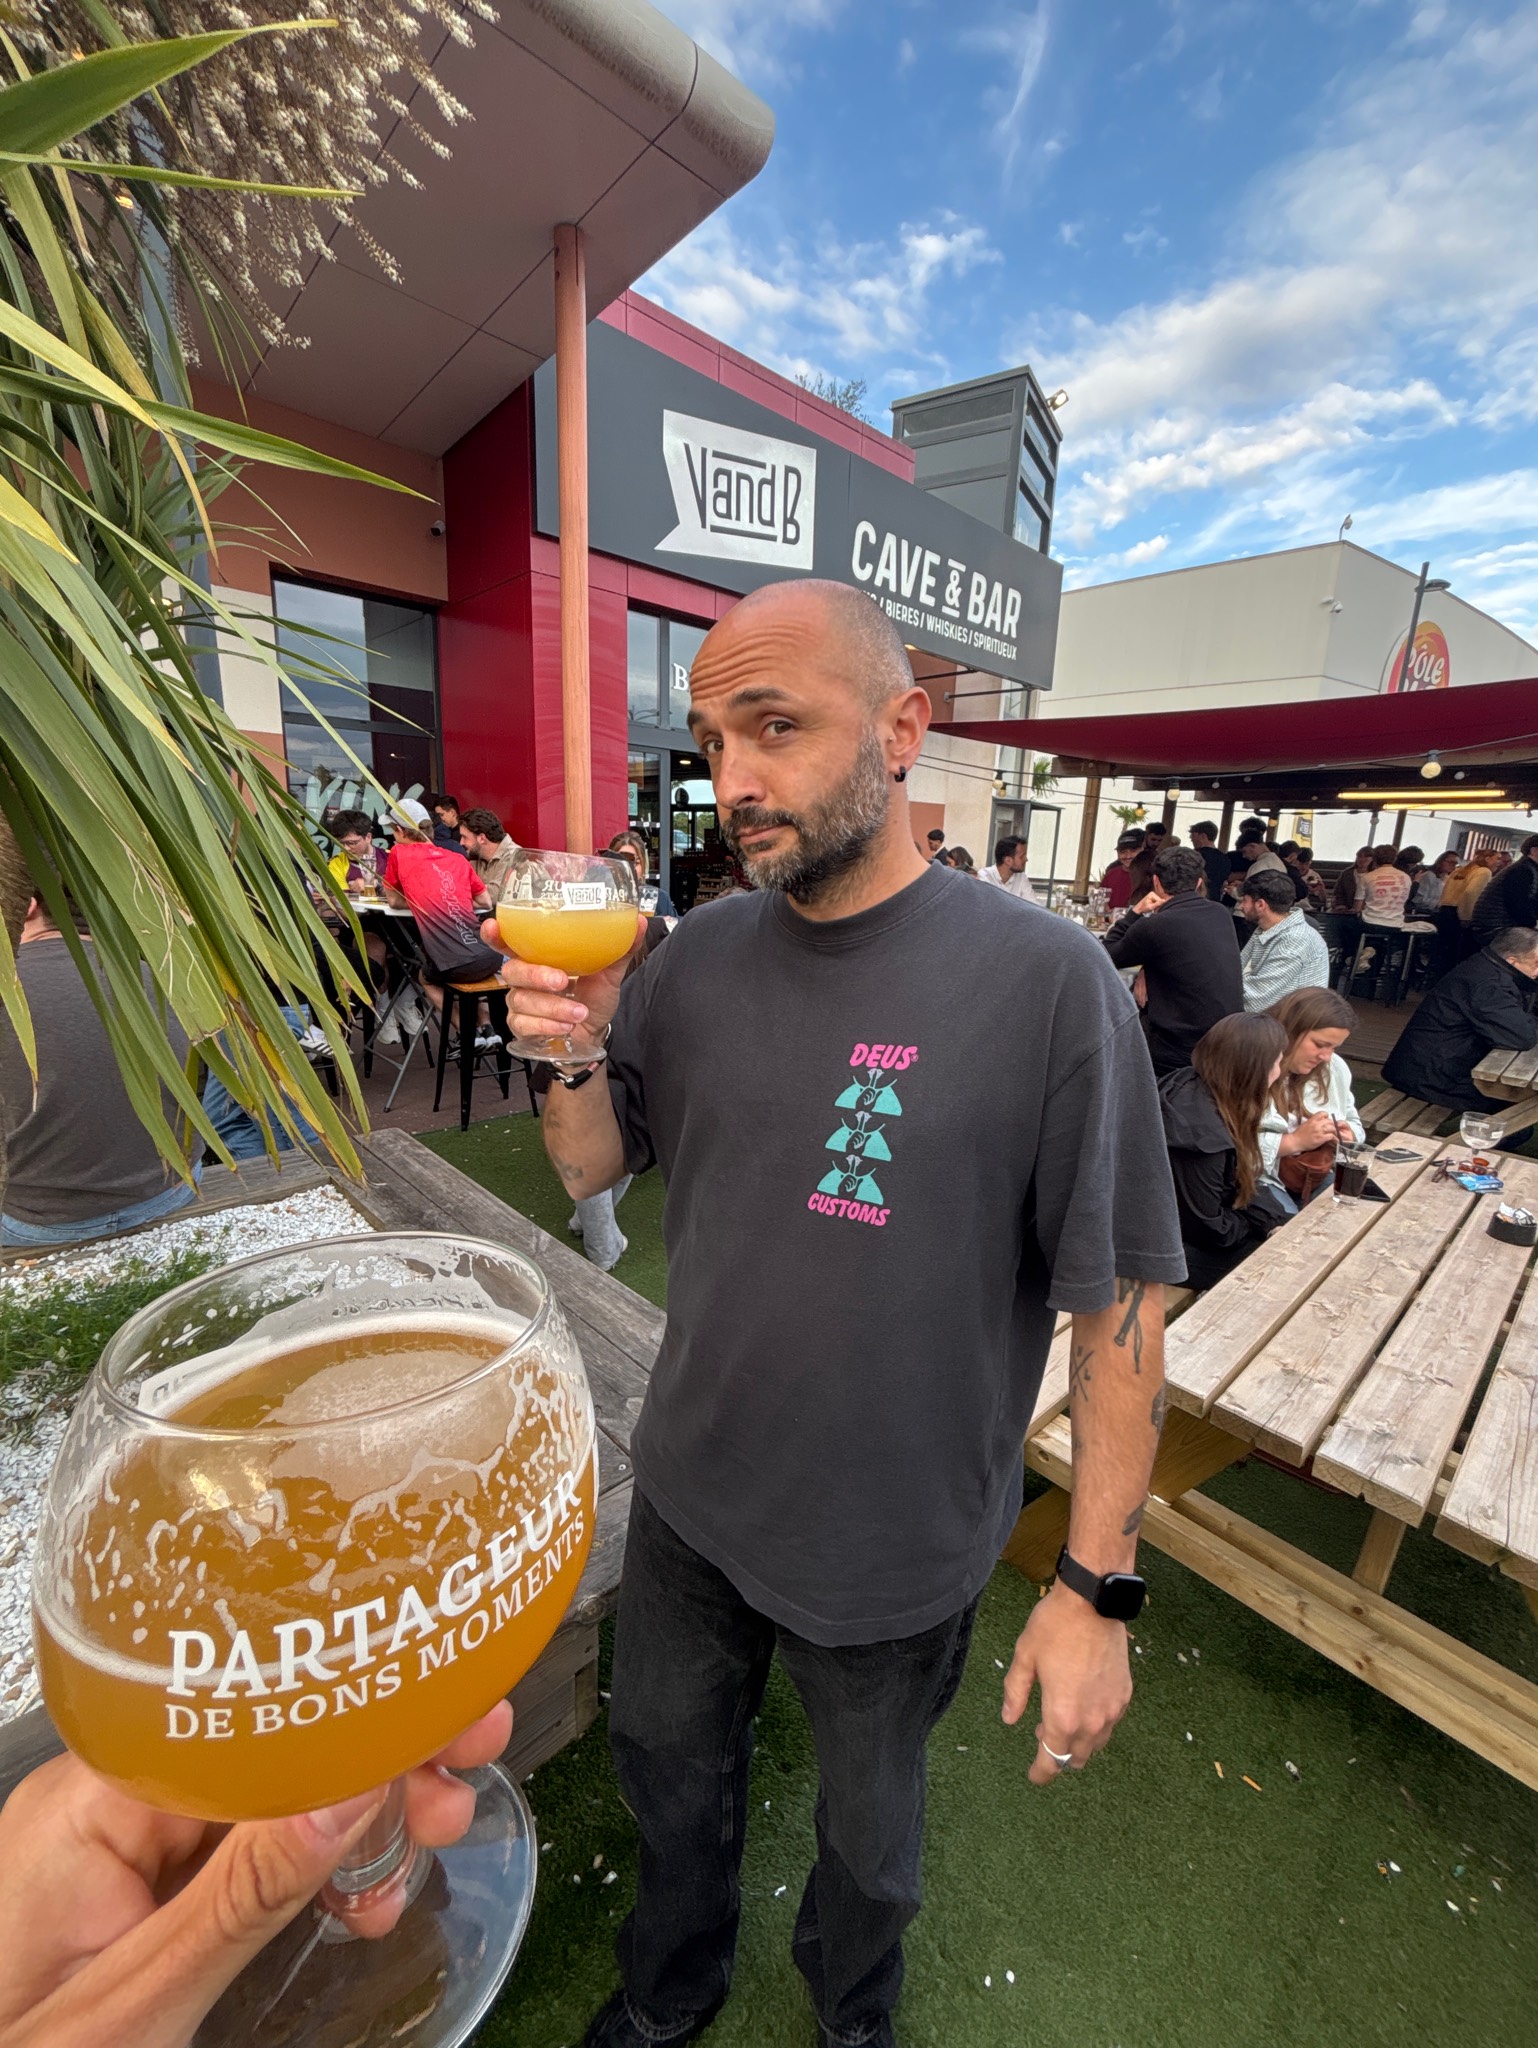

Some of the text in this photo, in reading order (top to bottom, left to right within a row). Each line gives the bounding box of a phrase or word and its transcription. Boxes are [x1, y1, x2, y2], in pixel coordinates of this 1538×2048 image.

[851, 520, 1022, 638] CAVE & BAR
[885, 599, 919, 627] BIERES
[926, 613, 968, 644] WHISKIES
[973, 633, 1018, 661] SPIRITUEUX
[807, 1193, 891, 1226] CUSTOMS
[165, 1510, 586, 1739] DE BONS MOMENTS
[166, 1471, 582, 1698] PARTAGEUR
